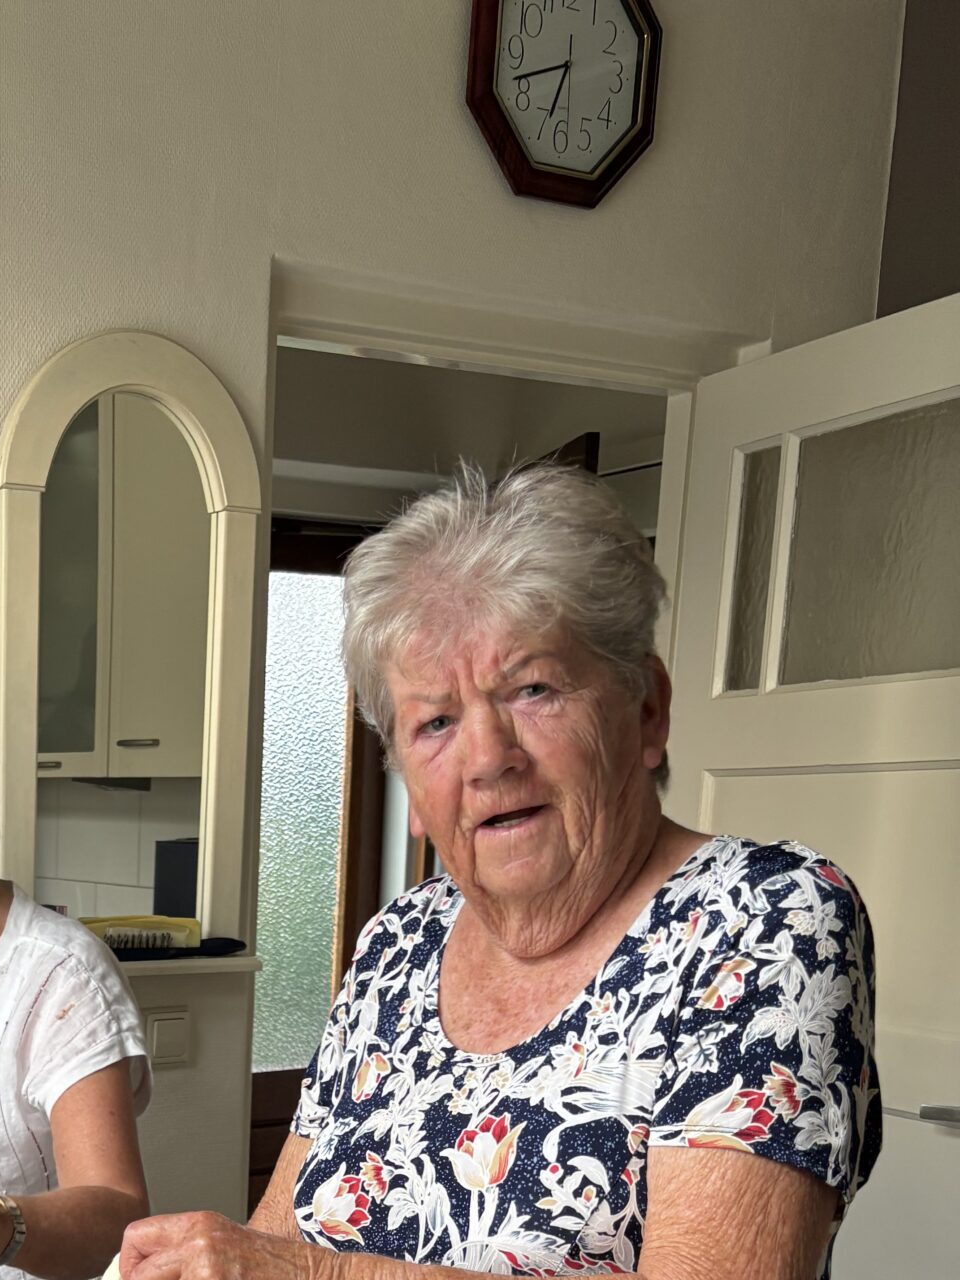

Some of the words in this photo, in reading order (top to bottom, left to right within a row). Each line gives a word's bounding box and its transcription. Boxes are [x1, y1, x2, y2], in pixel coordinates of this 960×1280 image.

[520, 1, 543, 38] 10
[508, 34, 524, 69] 9
[602, 20, 617, 55] 2
[515, 77, 530, 111] 8
[609, 60, 623, 94] 3
[537, 107, 550, 140] 7
[597, 97, 612, 129] 4
[553, 120, 568, 153] 6
[577, 117, 592, 151] 5
